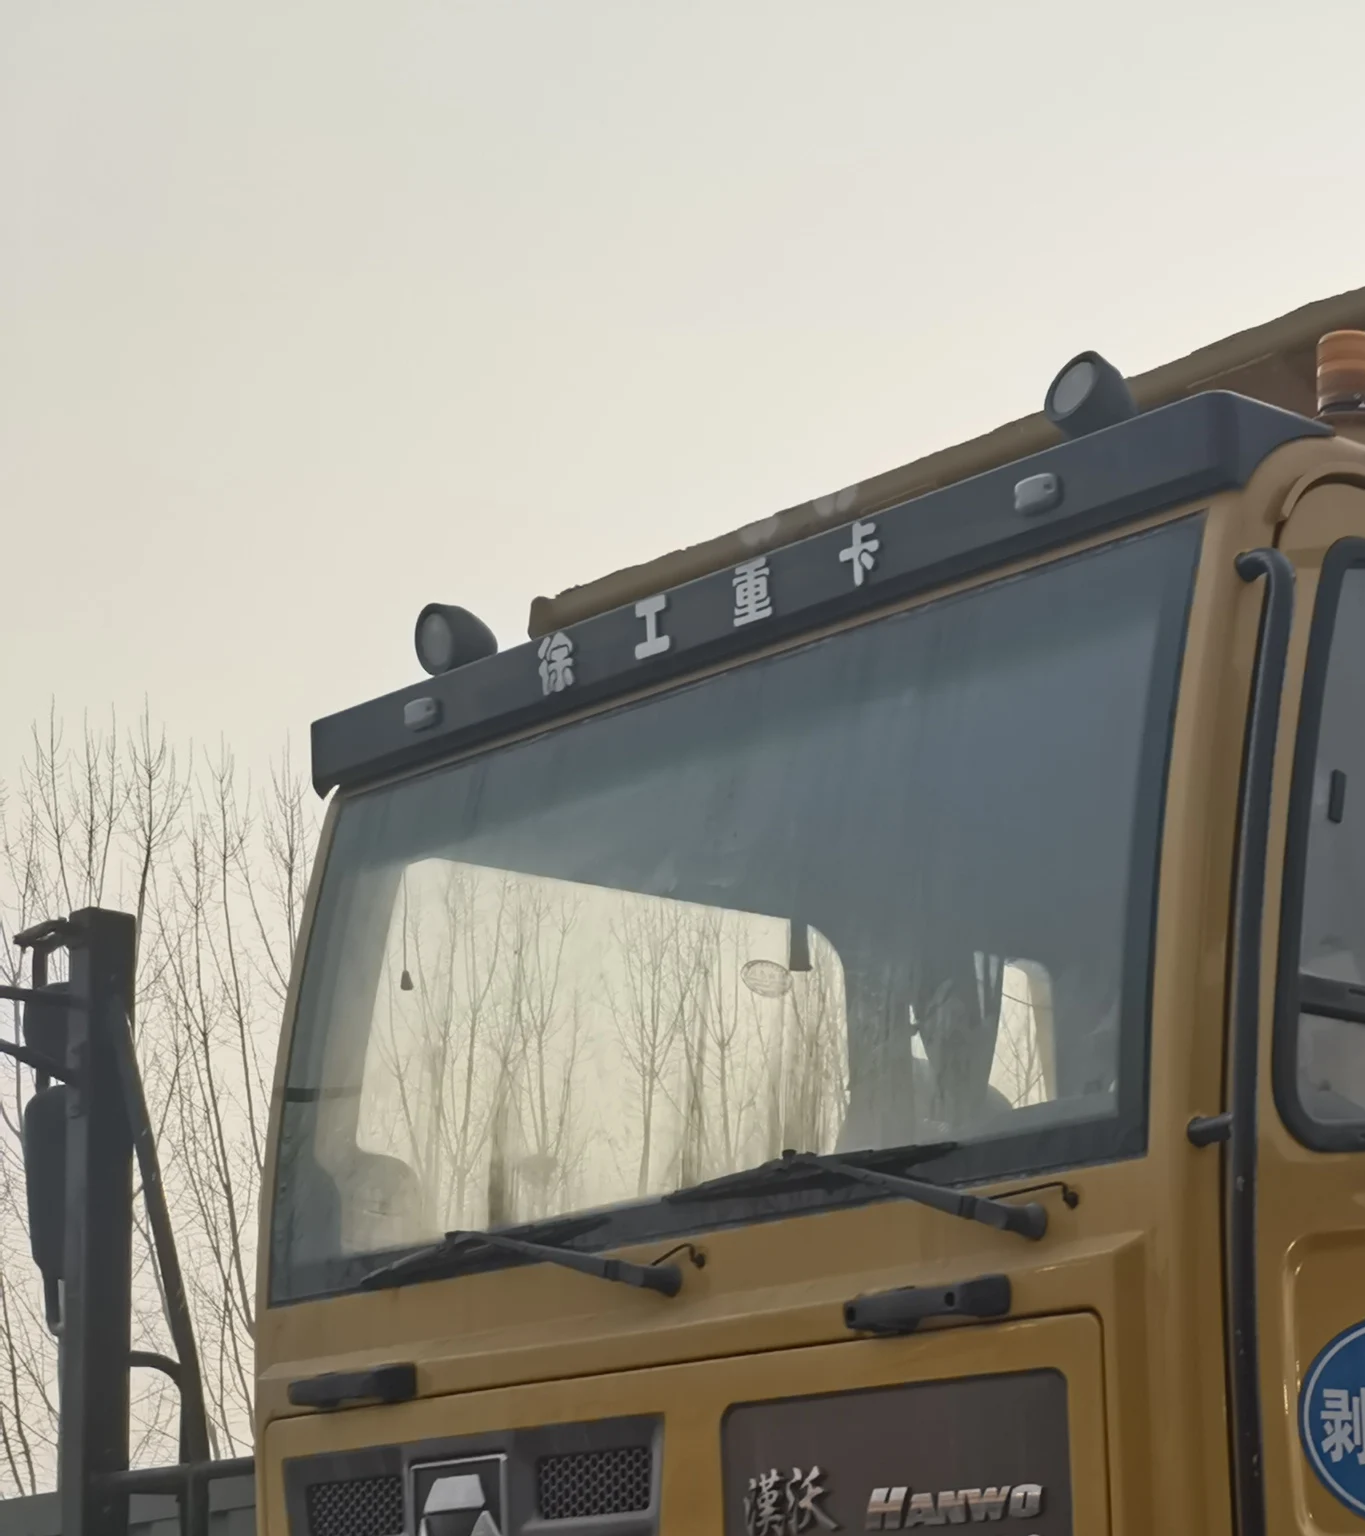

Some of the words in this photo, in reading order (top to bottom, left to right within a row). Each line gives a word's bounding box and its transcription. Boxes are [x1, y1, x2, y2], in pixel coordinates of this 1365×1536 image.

[538, 520, 880, 696] 徐工重卡
[744, 1465, 842, 1536] 漢沃
